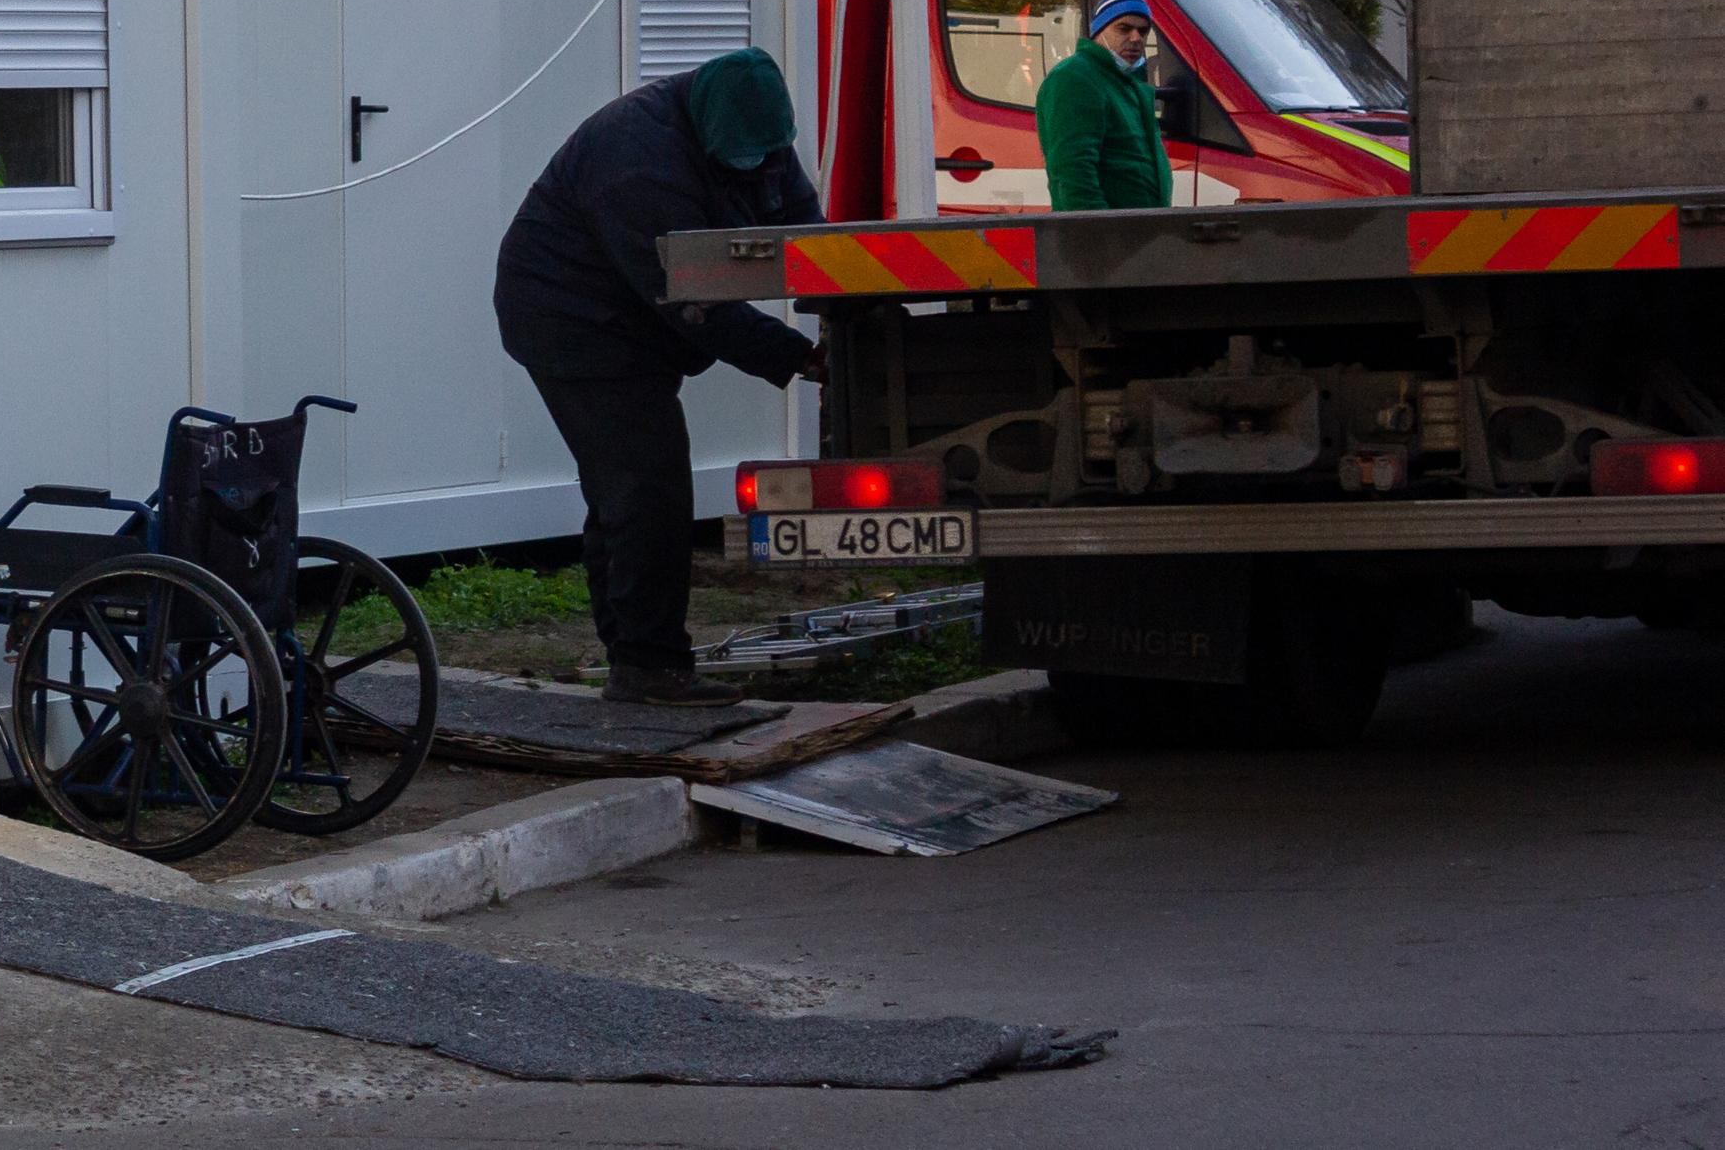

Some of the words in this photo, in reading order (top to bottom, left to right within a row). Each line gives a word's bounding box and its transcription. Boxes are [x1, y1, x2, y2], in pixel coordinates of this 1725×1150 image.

[752, 542, 768, 556] RO
[773, 518, 822, 556] GL
[1014, 618, 1212, 657] WUPINGER
